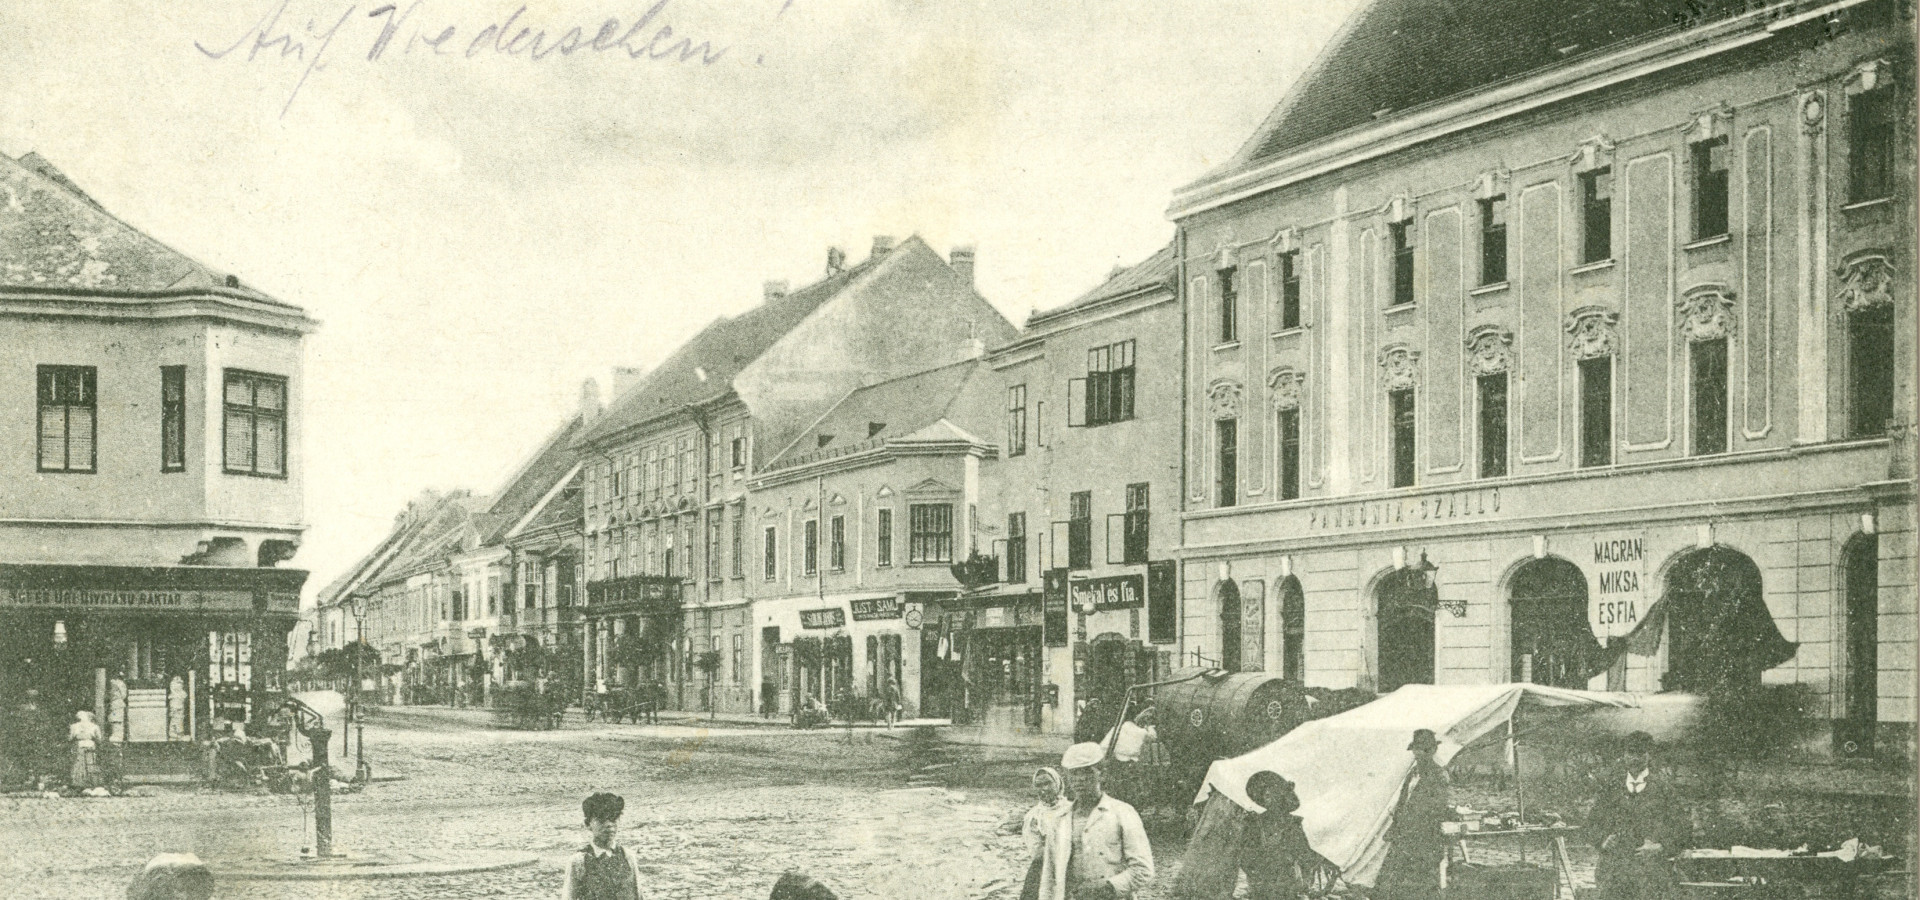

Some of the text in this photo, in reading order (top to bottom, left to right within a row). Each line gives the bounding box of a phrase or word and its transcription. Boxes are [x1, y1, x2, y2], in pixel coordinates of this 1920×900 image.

[1594, 538, 1643, 564] MAGRAN
[1599, 569, 1640, 594] MIKSA
[1617, 600, 1637, 624] FIA
